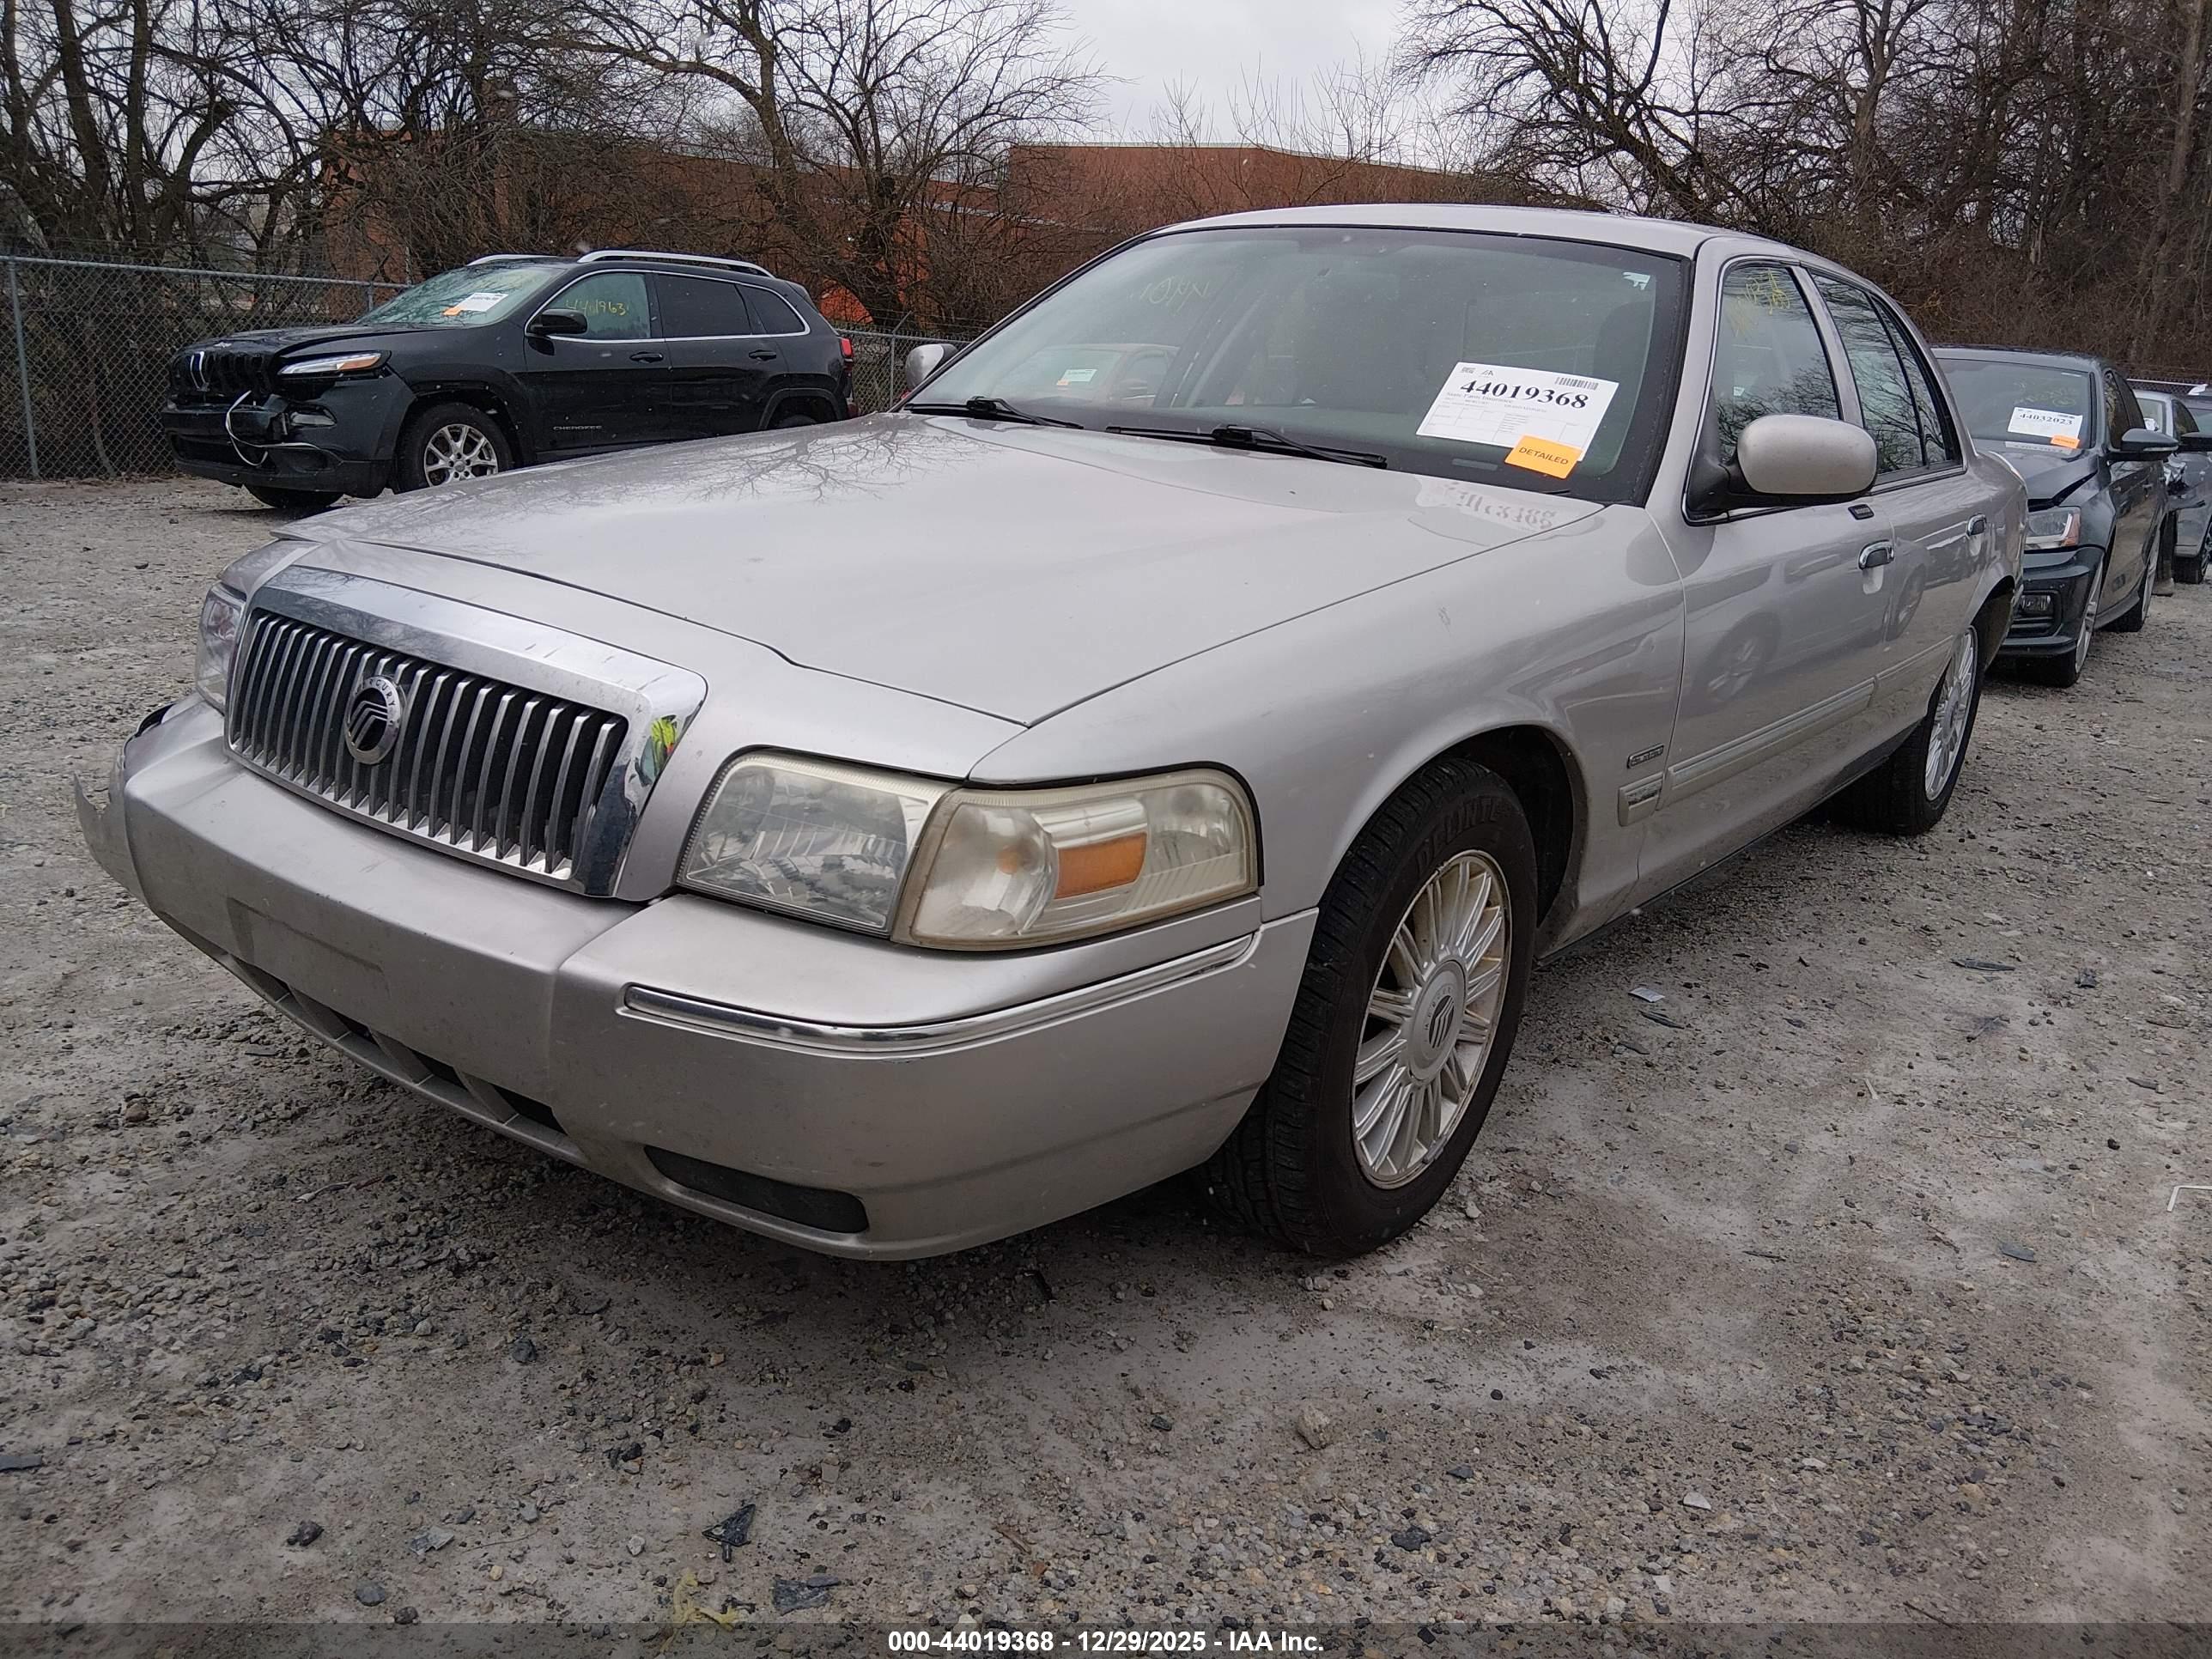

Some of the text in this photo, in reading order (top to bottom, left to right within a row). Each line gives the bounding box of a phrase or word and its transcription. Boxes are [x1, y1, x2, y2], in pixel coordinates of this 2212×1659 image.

[1461, 380, 1589, 409] 44019368
[2020, 413, 2073, 425] 44032023
[1519, 447, 1569, 465] DETAILED
